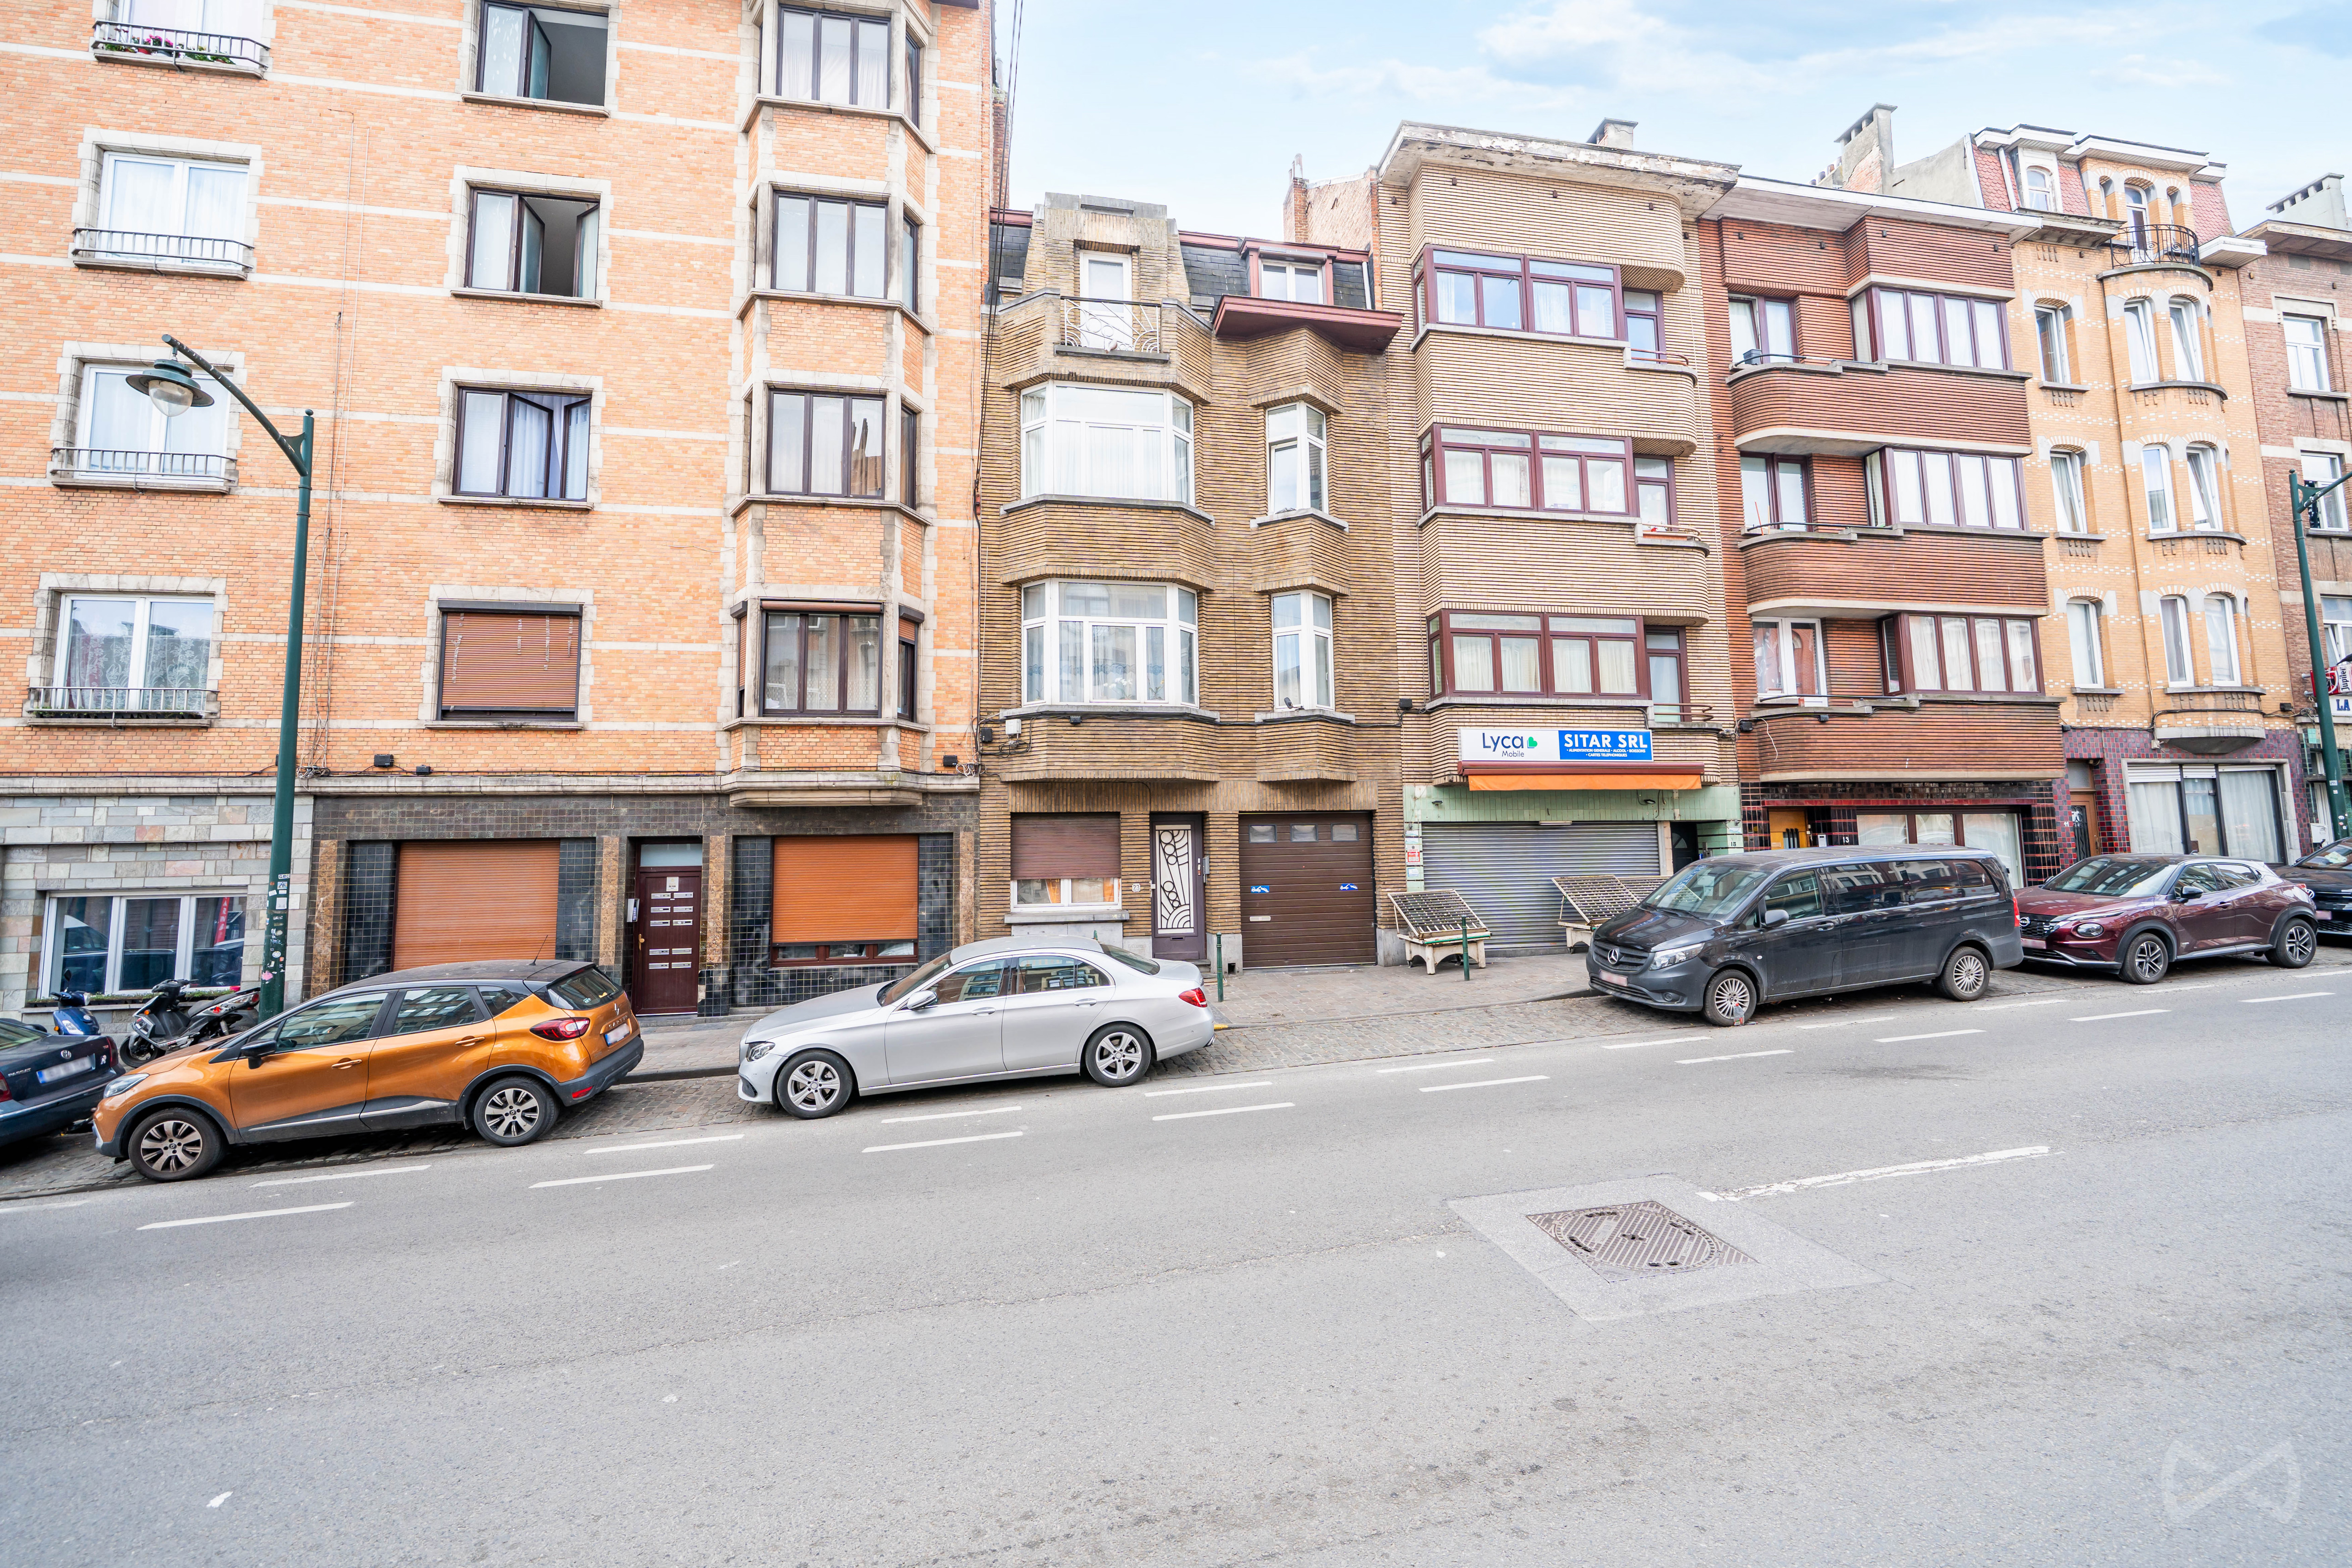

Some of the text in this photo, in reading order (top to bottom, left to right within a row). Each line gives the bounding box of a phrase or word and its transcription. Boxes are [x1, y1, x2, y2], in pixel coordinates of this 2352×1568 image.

[2339, 667, 2350, 691] Jupiler
[2336, 699, 2350, 711] LA
[1482, 733, 1524, 752] Lyca
[1564, 734, 1648, 748] SITAR SRL
